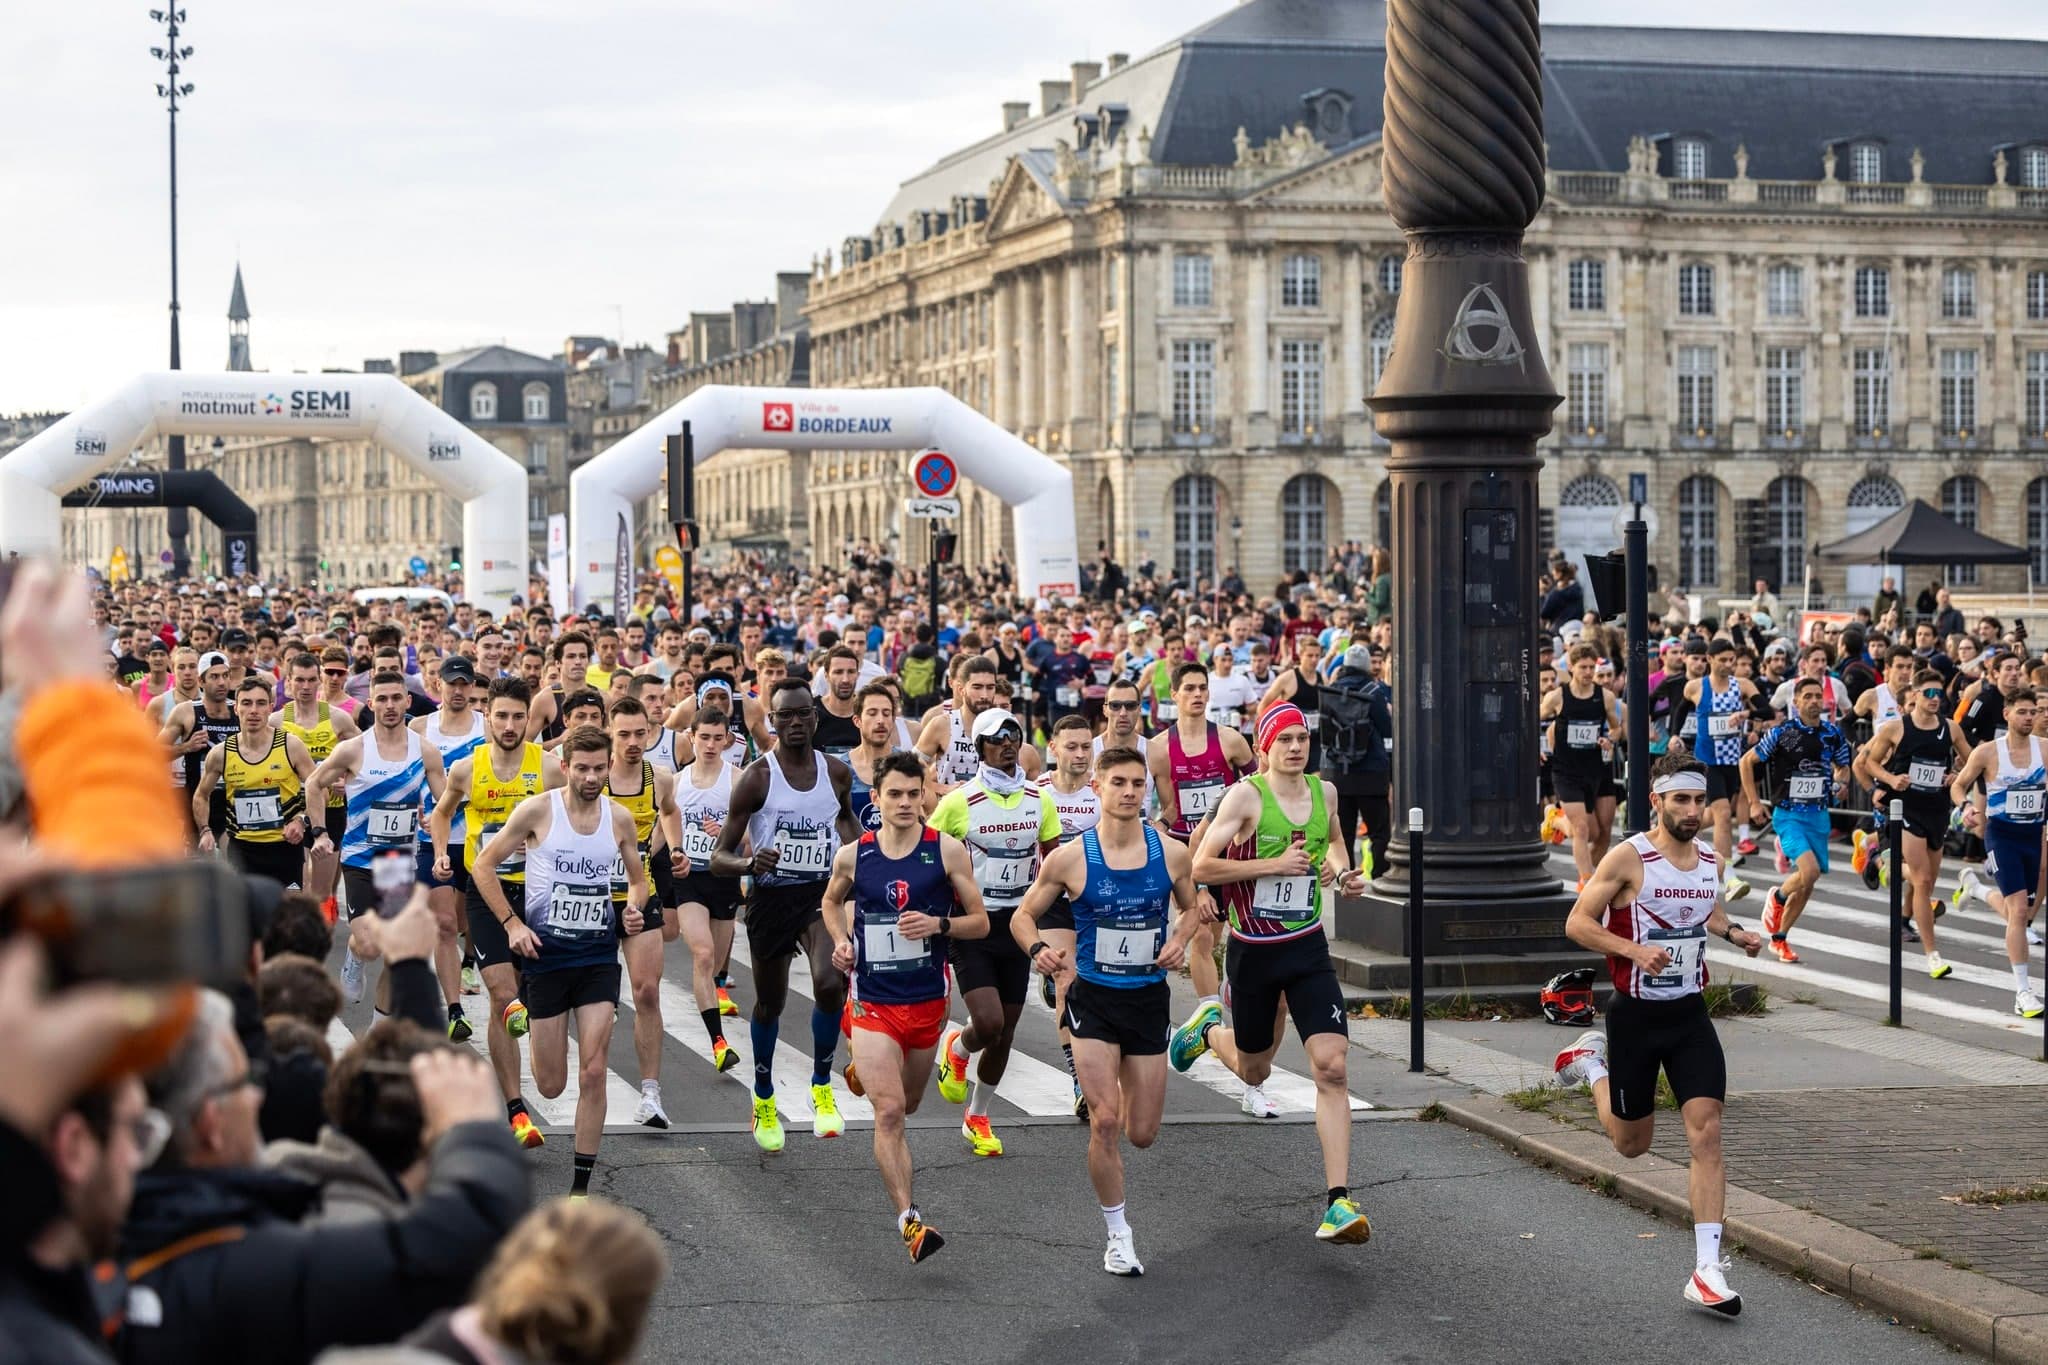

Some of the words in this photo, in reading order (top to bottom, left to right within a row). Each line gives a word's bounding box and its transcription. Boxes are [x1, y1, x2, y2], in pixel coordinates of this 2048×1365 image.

[182, 400, 256, 415] matmut
[291, 391, 350, 410] SEMI
[799, 418, 892, 432] BORDEAUX
[75, 440, 106, 453] SEMI
[429, 445, 461, 457] SEMI
[1575, 728, 1591, 740] 142
[1917, 768, 1936, 782] 190
[1797, 781, 1816, 793] 239
[1191, 792, 1207, 808] 21
[2016, 795, 2034, 808] 188
[246, 802, 261, 817] 71
[1056, 805, 1095, 814] RDEAUX
[383, 815, 399, 831] 16
[979, 821, 1038, 834] BORDEAUX
[1001, 864, 1018, 882] 41
[1274, 882, 1292, 903] 18
[1655, 888, 1715, 899] BORDEAUX
[551, 899, 601, 922] 15015
[887, 931, 895, 952] 1
[1118, 936, 1129, 957] 4
[1663, 946, 1684, 967] 24
